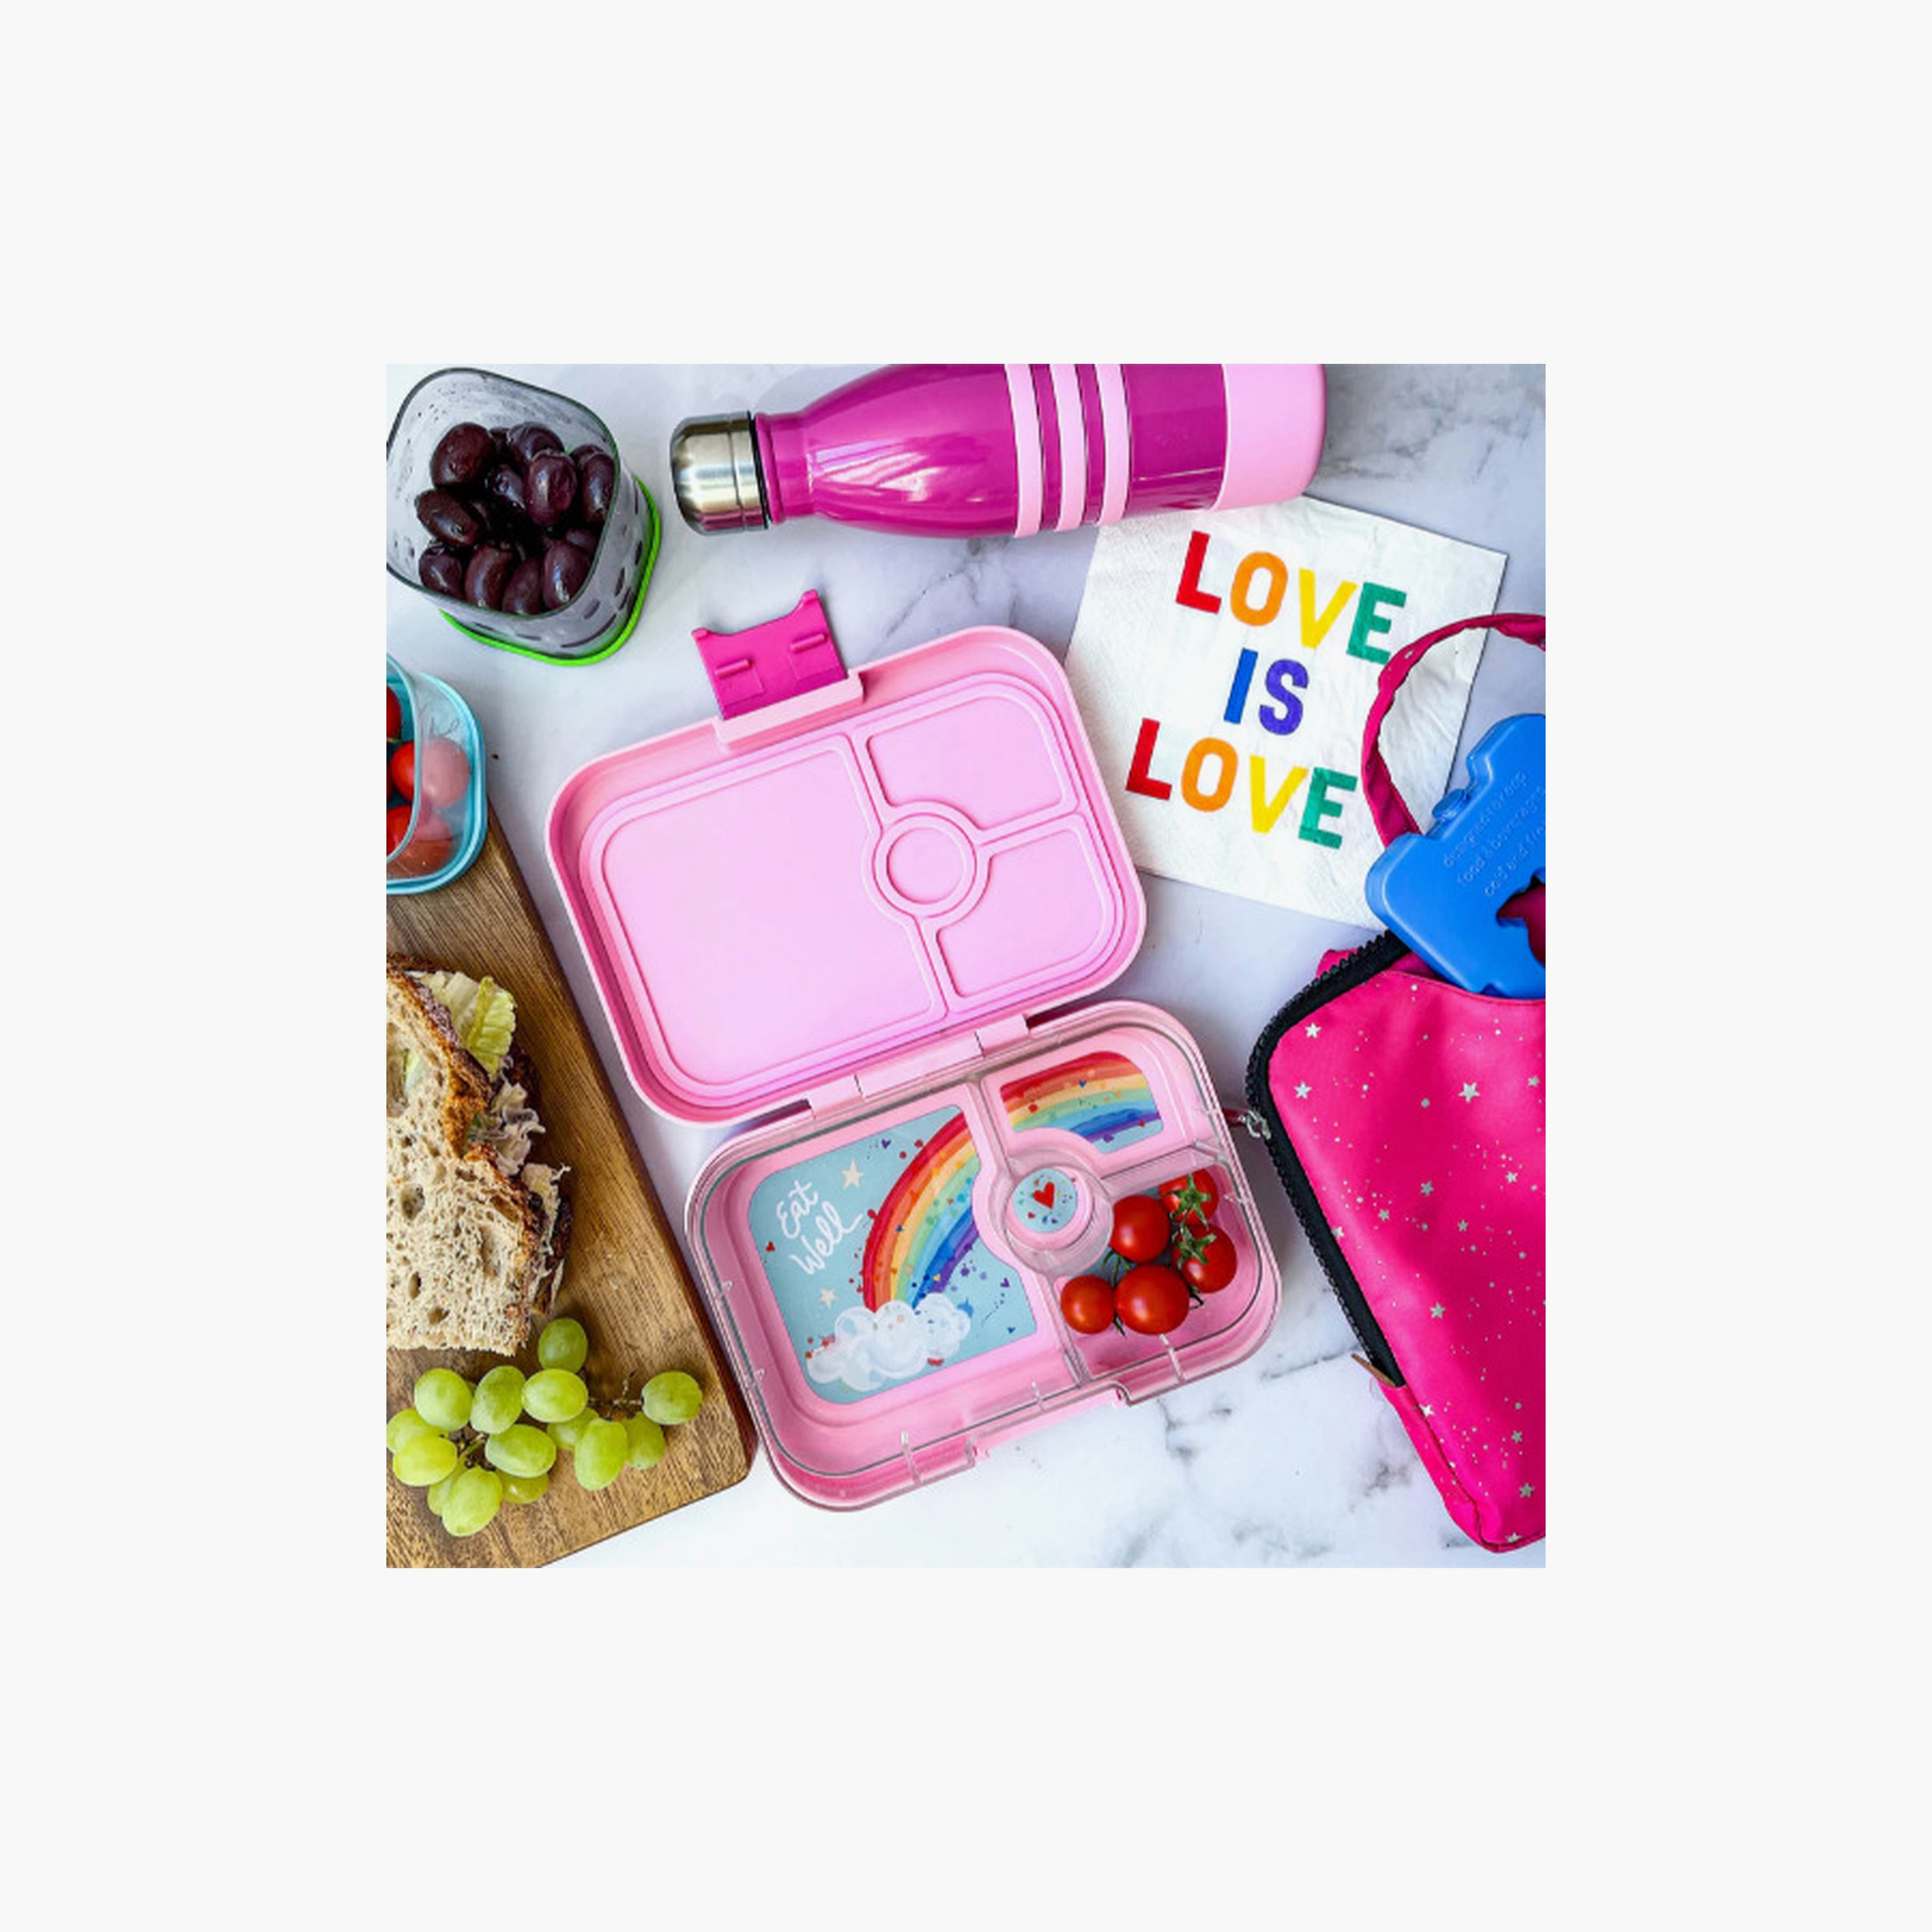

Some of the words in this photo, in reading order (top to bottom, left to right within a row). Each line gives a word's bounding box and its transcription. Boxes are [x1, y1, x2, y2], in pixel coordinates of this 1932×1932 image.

[1176, 531, 1406, 665] LOVE
[1224, 648, 1308, 734] IS
[1126, 718, 1357, 848] LOVE
[777, 1180, 819, 1238] Eat
[789, 1201, 864, 1275] Well
